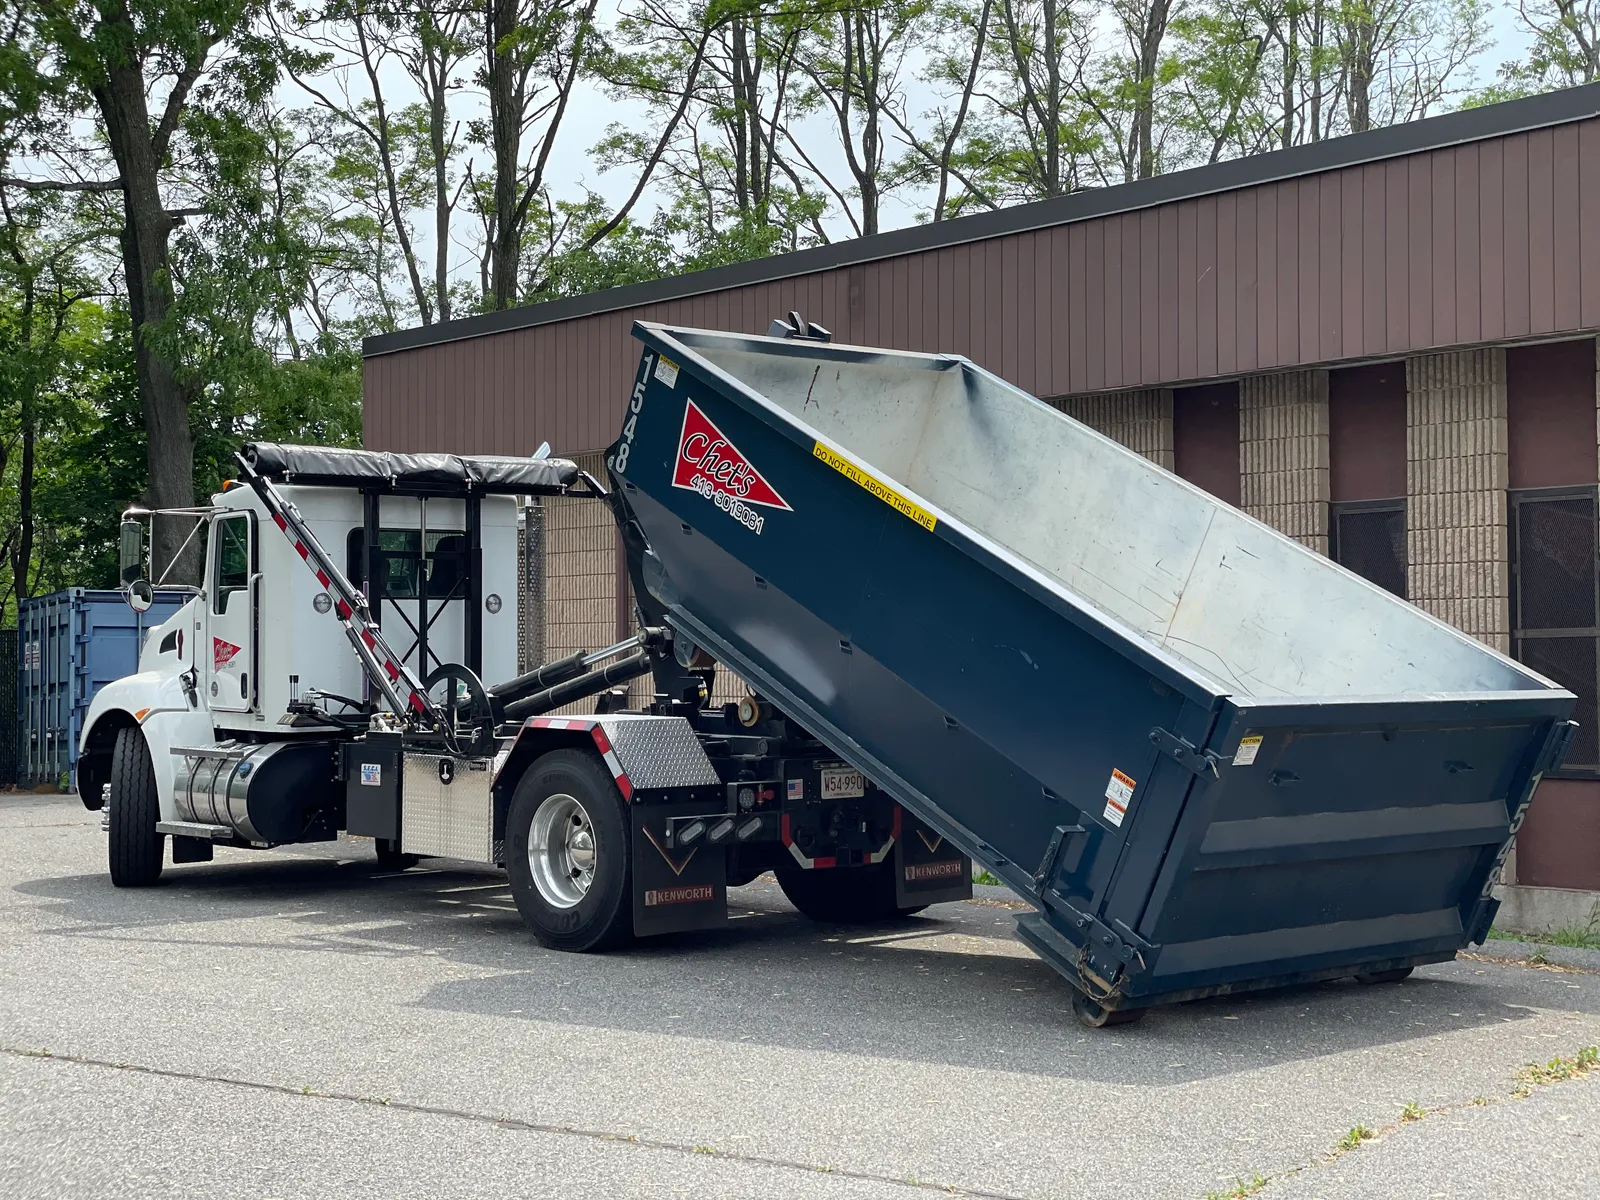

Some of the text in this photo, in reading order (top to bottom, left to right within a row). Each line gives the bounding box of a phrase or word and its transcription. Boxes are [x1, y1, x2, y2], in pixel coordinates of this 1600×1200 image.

[615, 354, 654, 474] 1548
[682, 432, 756, 496] Chet's
[815, 447, 933, 529] DO NOT FILL ABOVE THIS LINE
[690, 473, 764, 535] 413 3019081
[1482, 771, 1543, 898] 1548
[657, 888, 712, 902] KENWORTH
[916, 863, 961, 877] KENWORTH
